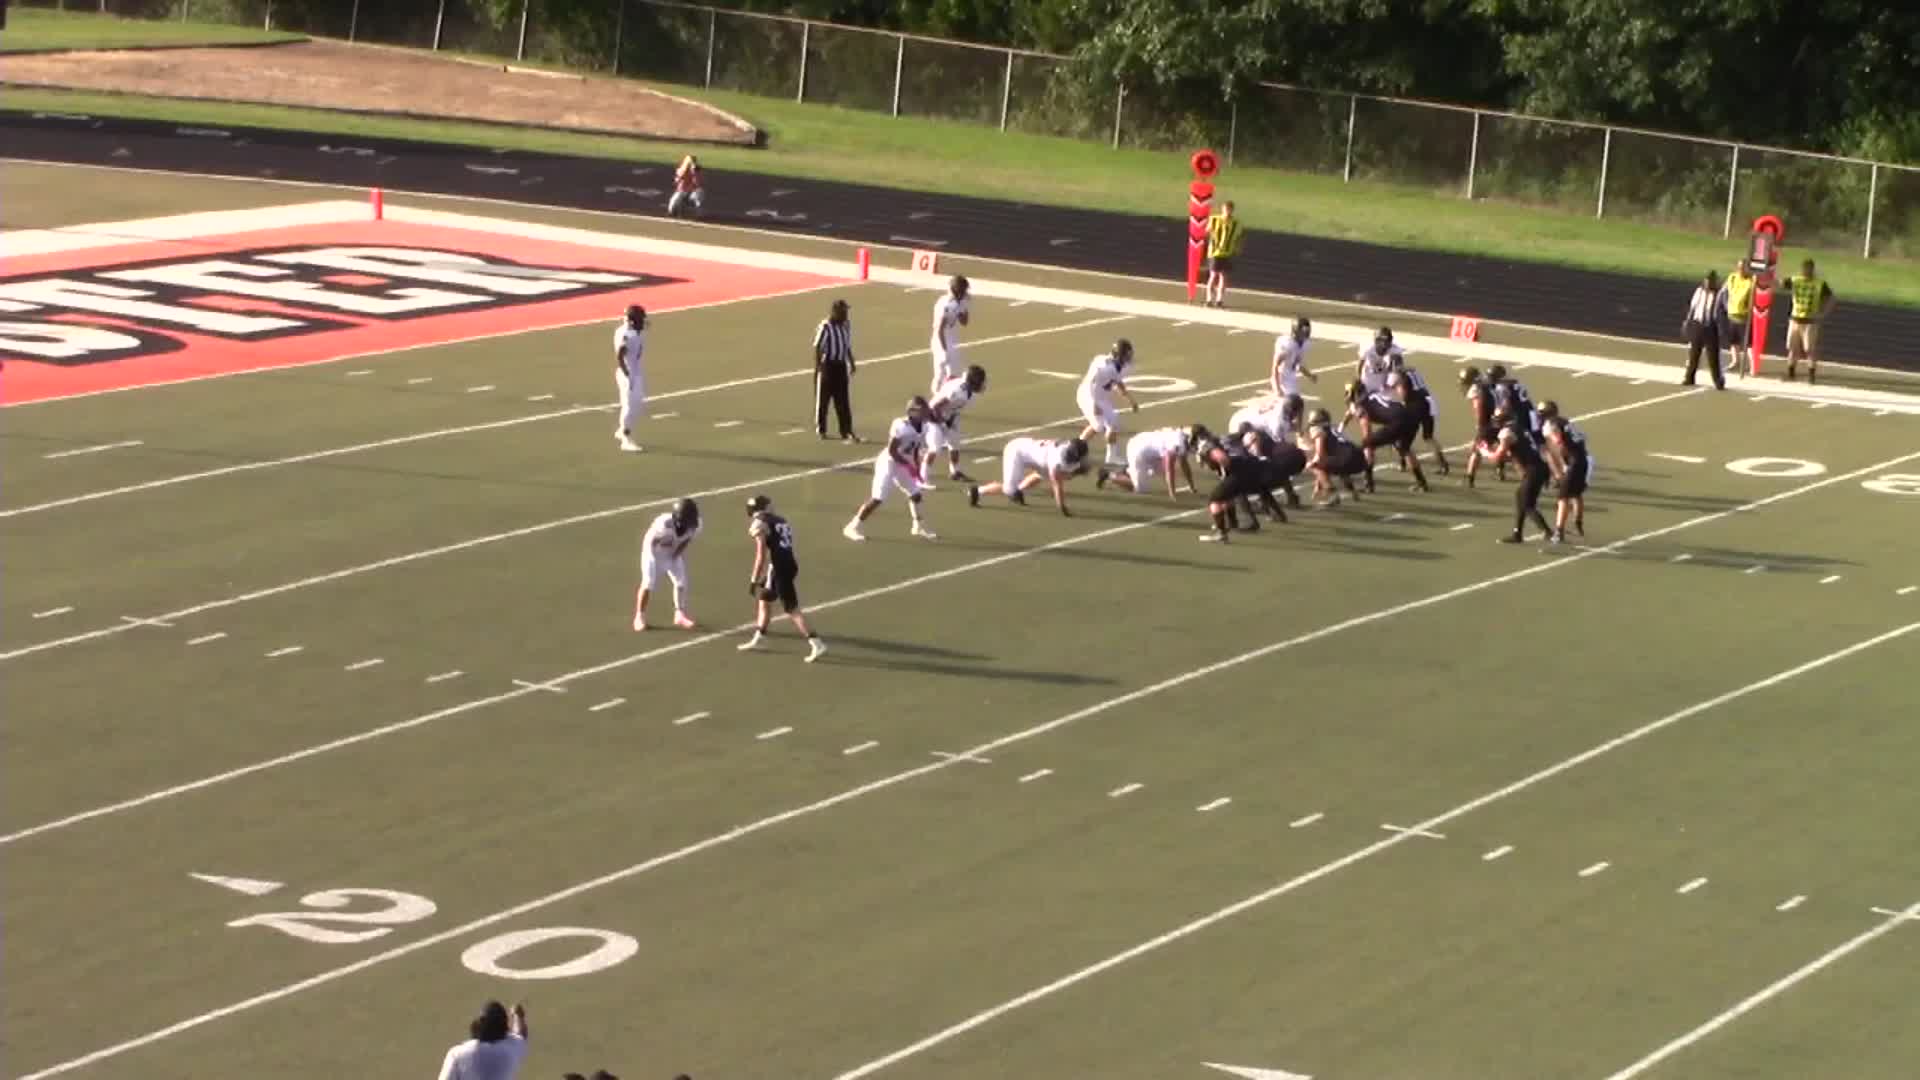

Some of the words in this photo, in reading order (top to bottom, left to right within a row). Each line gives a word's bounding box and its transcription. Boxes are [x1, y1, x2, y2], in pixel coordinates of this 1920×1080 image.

[919, 254, 930, 271] G
[1454, 319, 1475, 338] 10
[225, 887, 639, 979] 20
